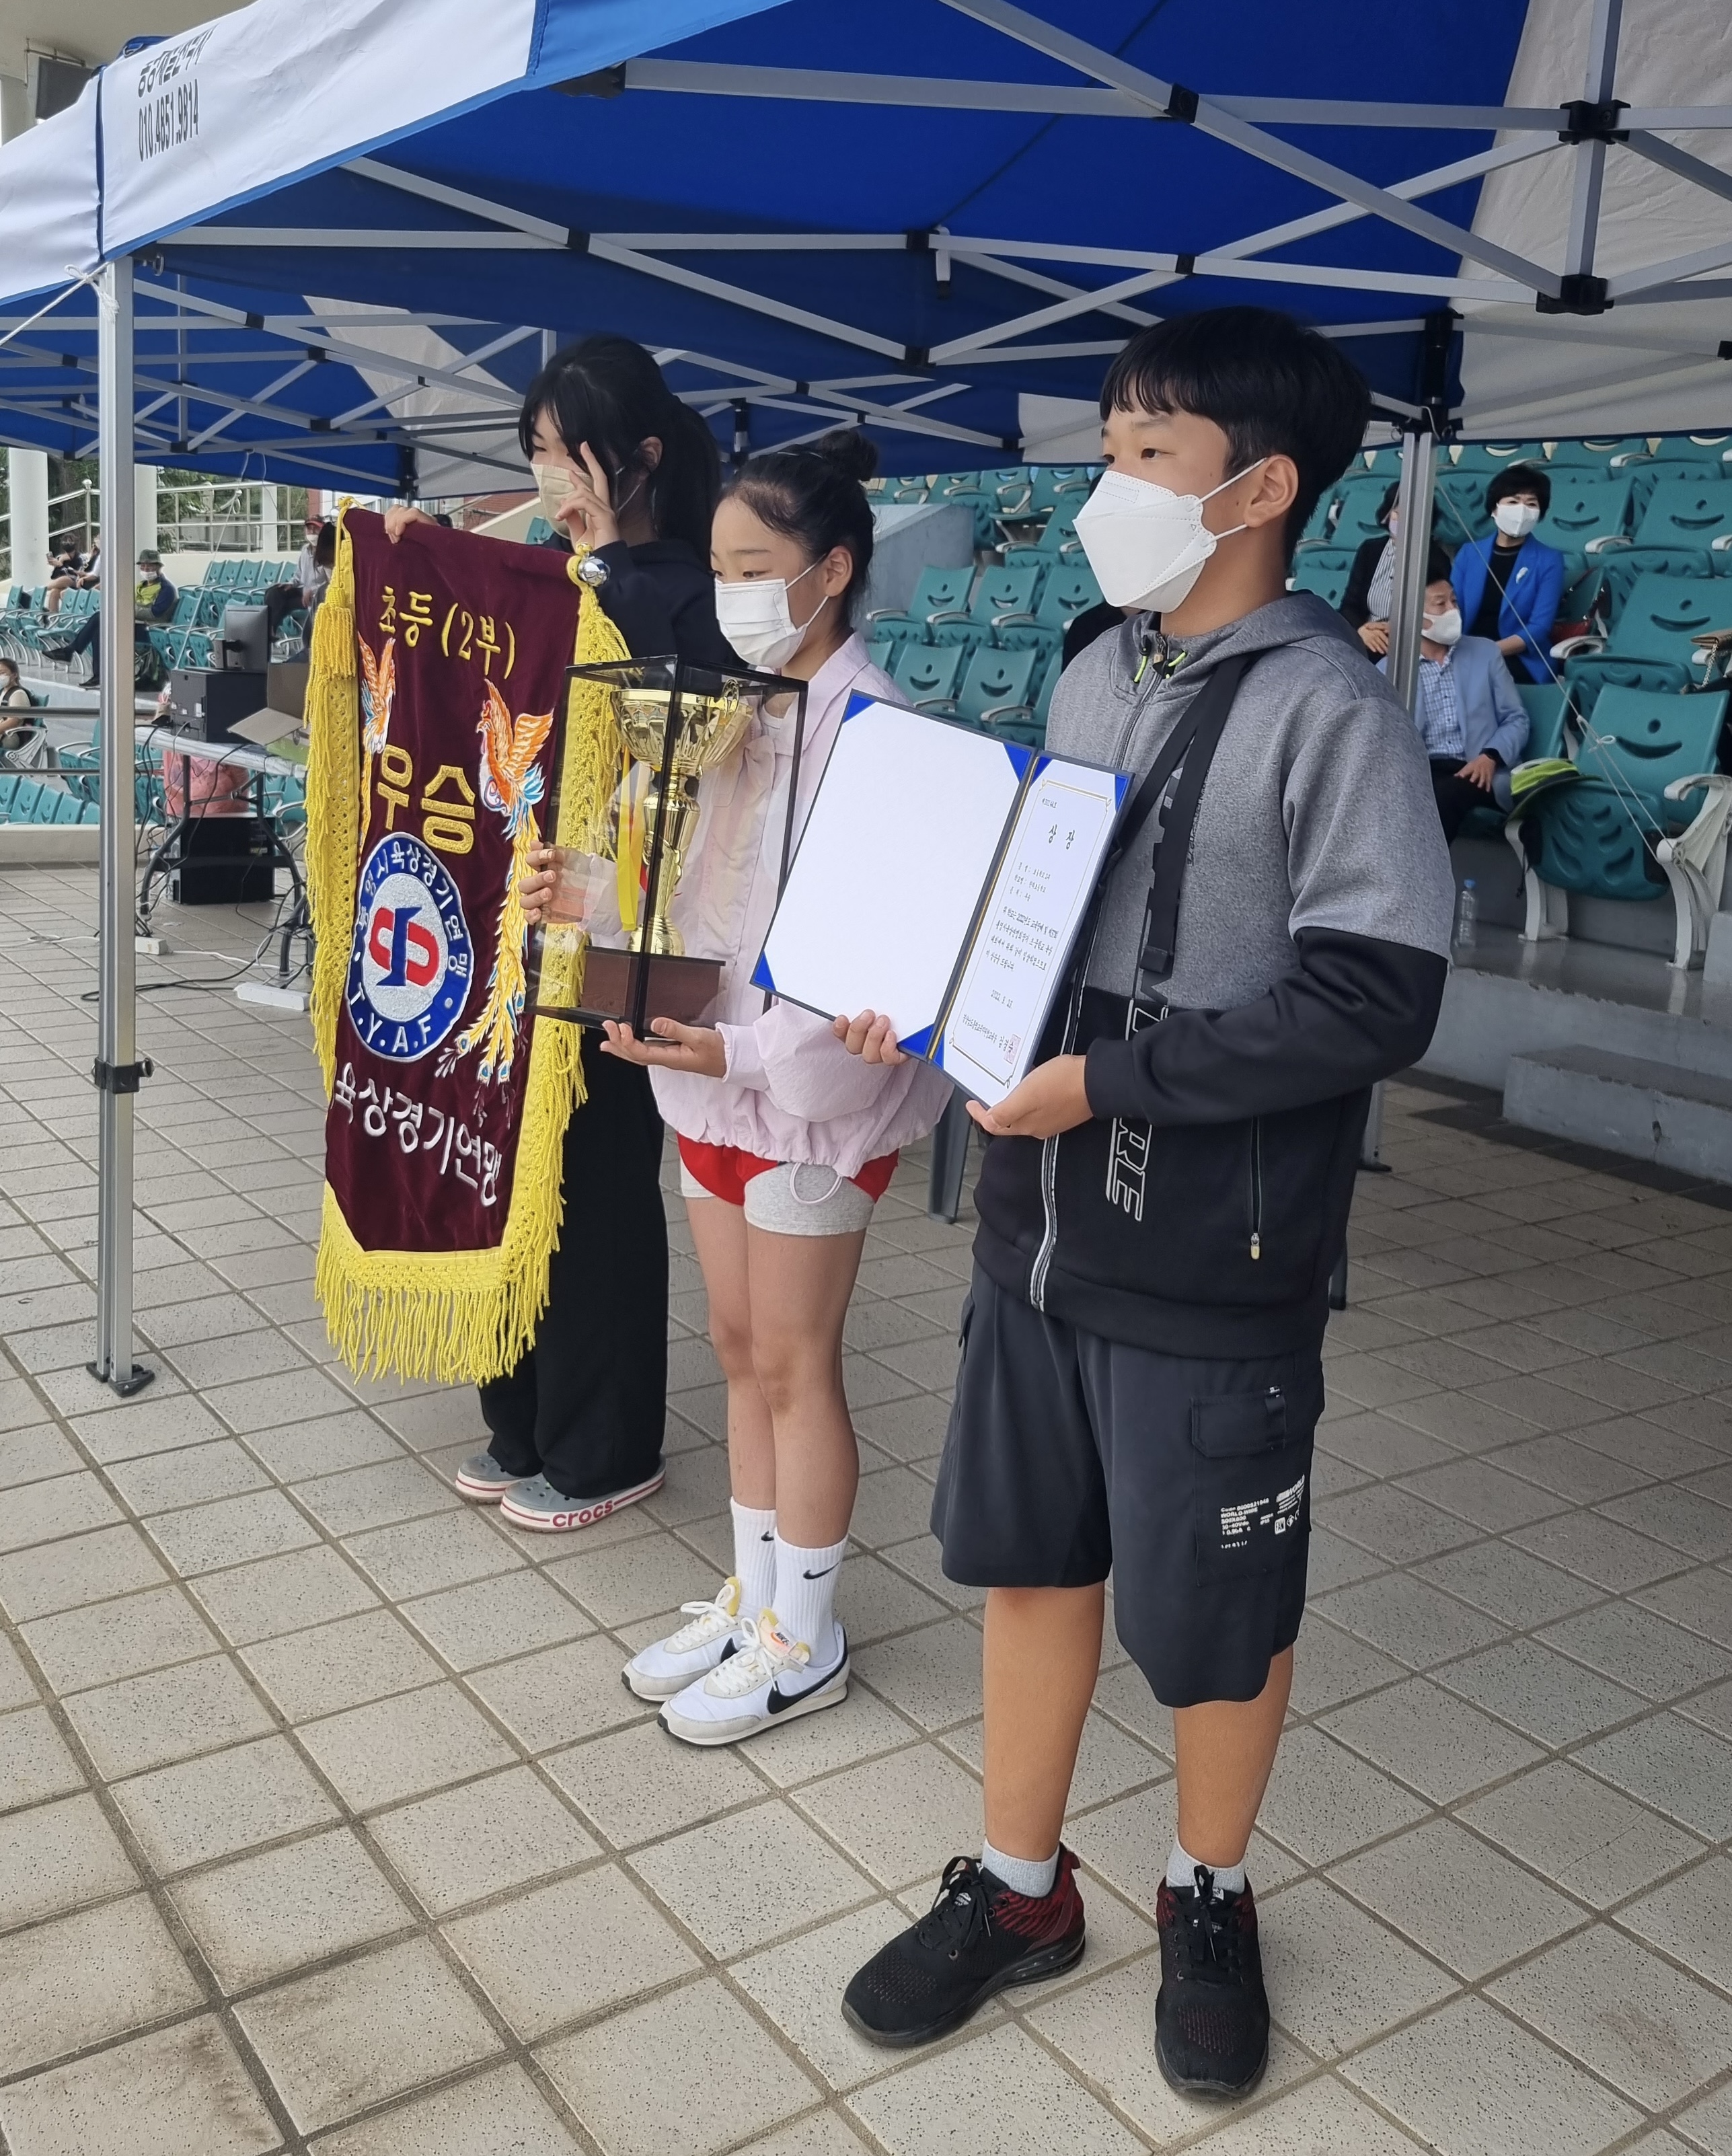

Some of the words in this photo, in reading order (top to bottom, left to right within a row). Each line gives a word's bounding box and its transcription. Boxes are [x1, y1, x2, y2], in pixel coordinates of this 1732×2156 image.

[138, 79, 200, 162] 010.4851.9814
[375, 743, 476, 854] 우승
[1049, 824, 1057, 844] 상
[1065, 829, 1075, 850] 장
[331, 1061, 502, 1208] 육상경기연맹
[552, 1499, 613, 1528] crocs
